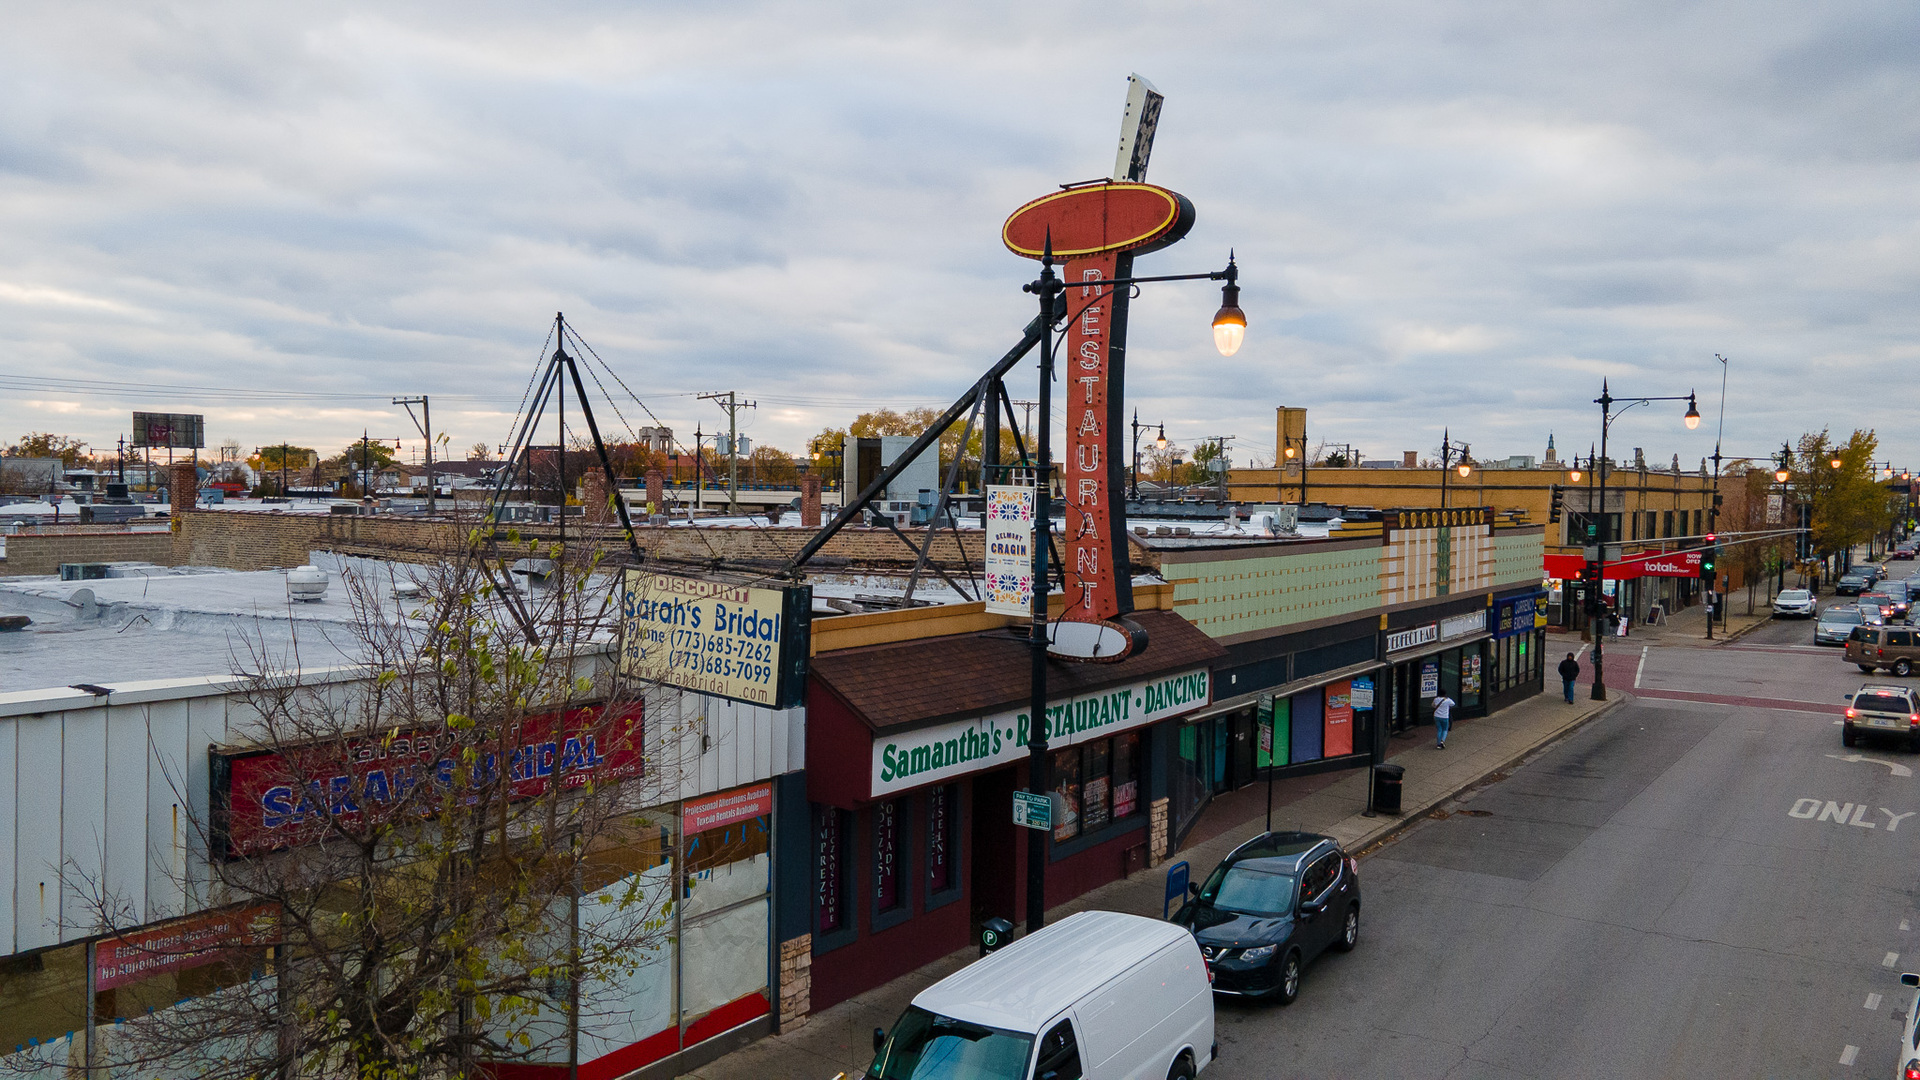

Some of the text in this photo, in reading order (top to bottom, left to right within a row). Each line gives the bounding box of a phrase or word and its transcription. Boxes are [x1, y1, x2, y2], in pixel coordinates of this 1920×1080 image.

[1076, 268, 1104, 610] RESTAURANT
[990, 542, 1028, 557] CRAGIN
[995, 531, 1023, 541] BELMONT
[1644, 562, 1673, 574] total
[655, 575, 749, 603] DISCOUNT
[625, 591, 781, 643] Sarah's Bridal
[670, 629, 772, 664] (773)685-7262
[1387, 627, 1436, 649] PERFECT HAIR
[630, 660, 730, 695] ww.sarahbridal
[668, 650, 772, 685] (773)685-7099
[1421, 685, 1437, 693] LEASE
[880, 720, 1001, 783] Samantha's
[1015, 688, 1132, 748] RSTAURANT
[1144, 670, 1207, 714] DANCING
[471, 735, 605, 789] BRIDAL
[684, 788, 770, 817] Professional Alterations Available
[1033, 796, 1048, 805] PARK
[1787, 797, 1917, 832] ONLY
[696, 803, 760, 827] Tuxedo Rentals Available
[885, 803, 894, 876] OBIADY
[145, 934, 181, 951] Orders
[987, 932, 994, 943] P
[102, 966, 116, 980] No
